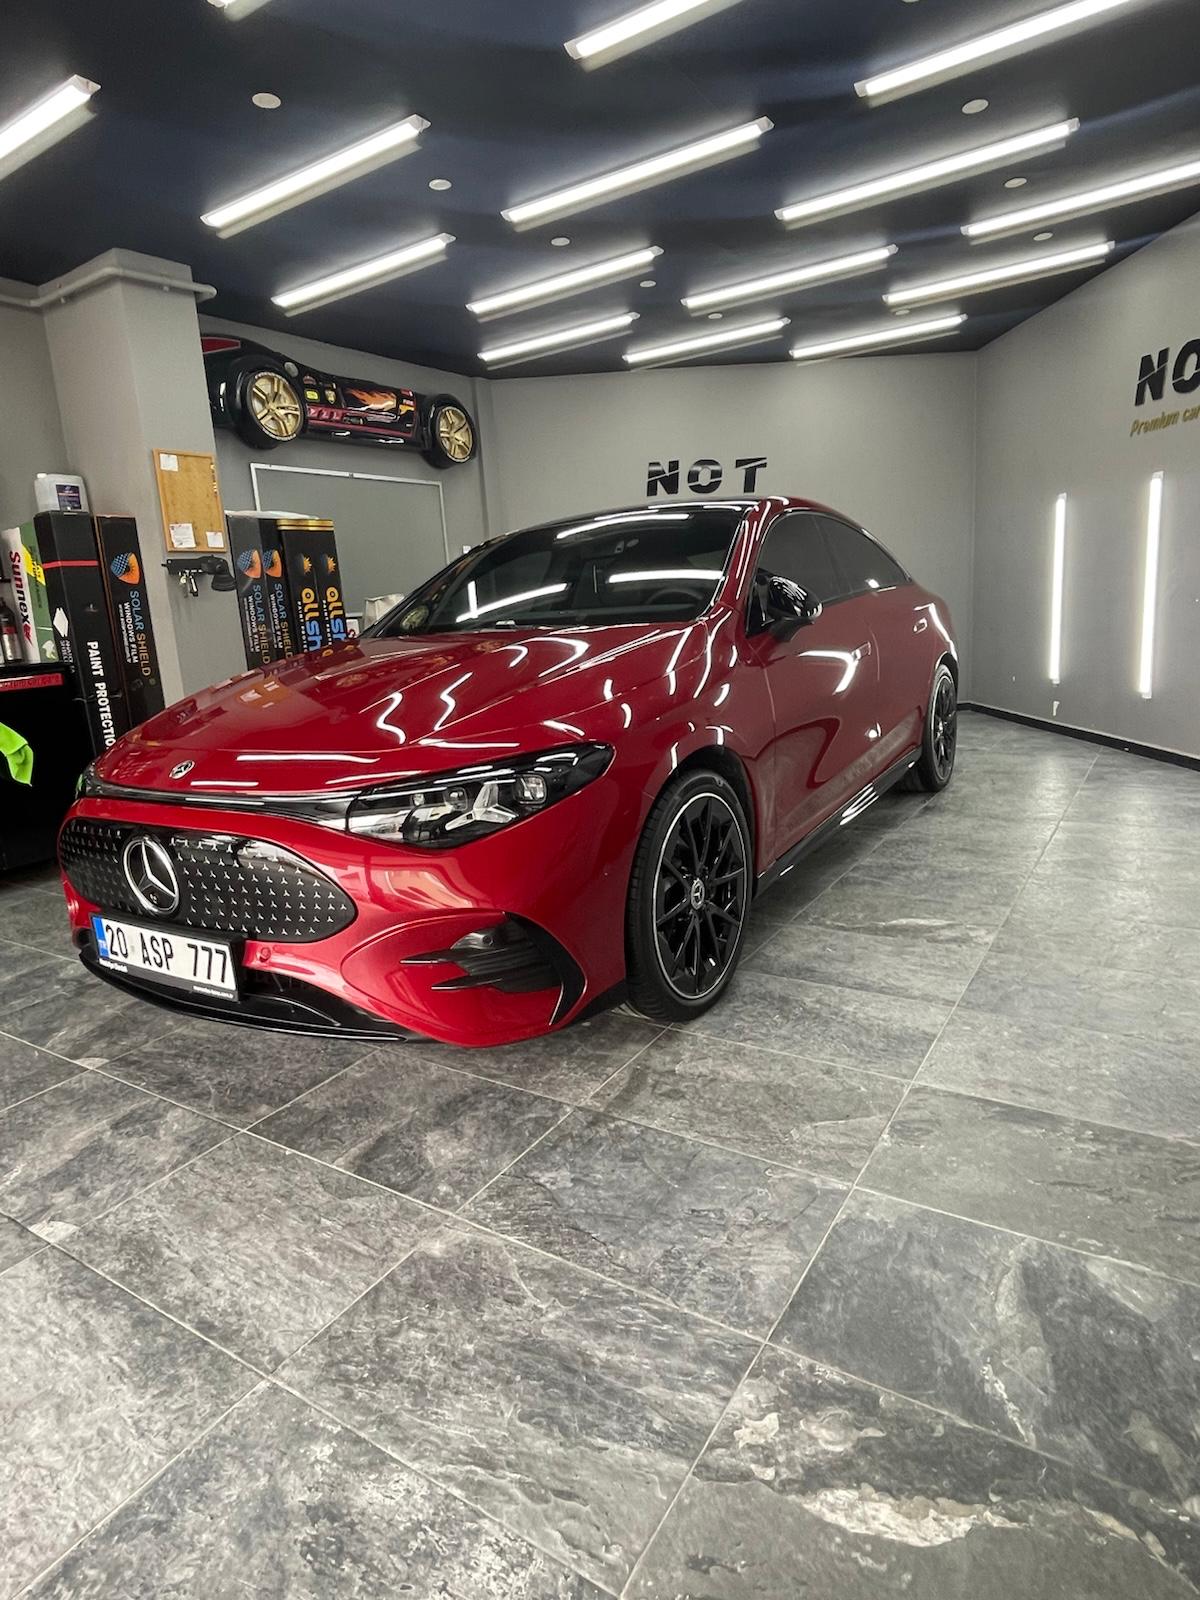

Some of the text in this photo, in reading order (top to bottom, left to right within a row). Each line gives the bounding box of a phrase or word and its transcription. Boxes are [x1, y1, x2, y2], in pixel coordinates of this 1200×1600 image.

[647, 457, 767, 496] NOT
[9, 551, 31, 624] Sunnex
[248, 595, 258, 633] WINDOWS
[270, 593, 280, 630] WINDOWS
[274, 583, 287, 619] SOLAR
[124, 602, 136, 642] WINDOWS
[130, 644, 139, 663] FILM
[129, 590, 151, 676] SOLAR SHIELD
[253, 584, 271, 664] SOLAR SHIELD
[87, 641, 116, 749] PAINT PROTECTIO
[105, 924, 227, 983] 20 ASP 777
